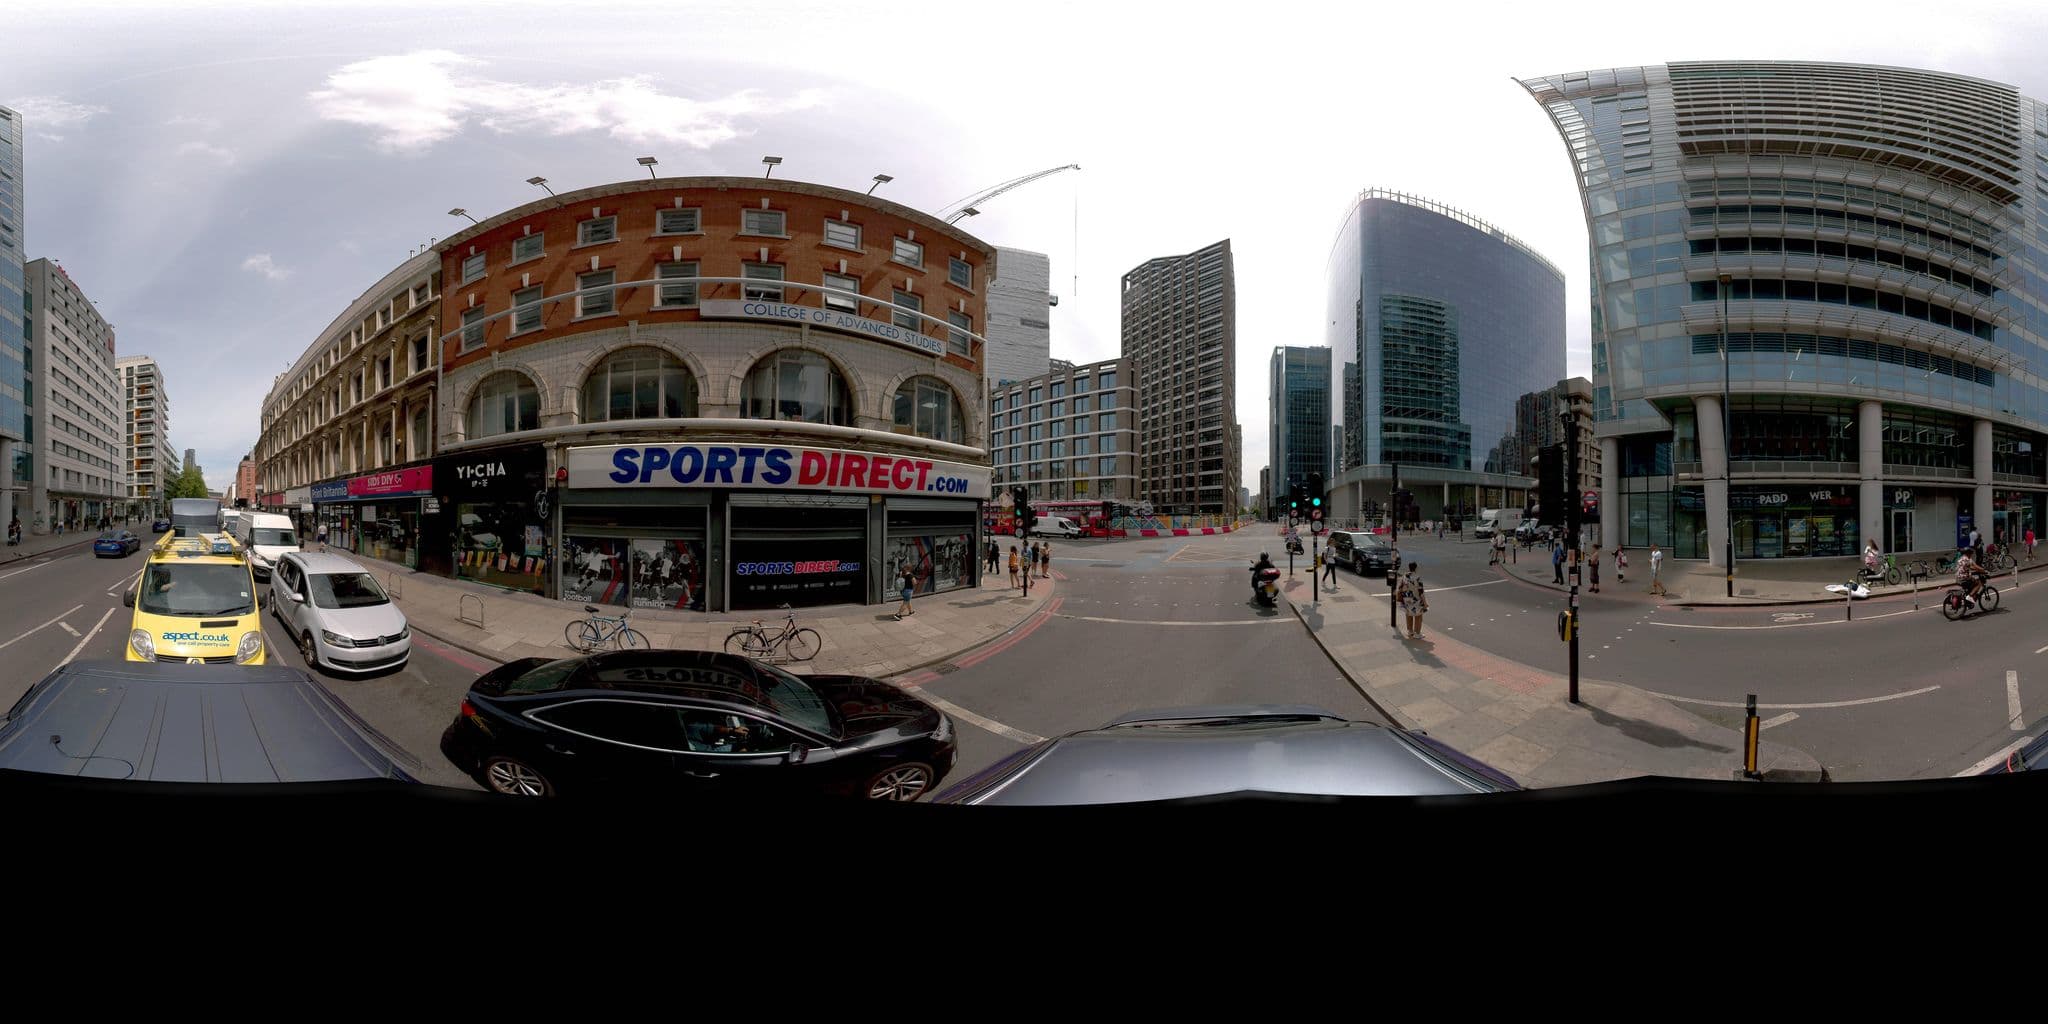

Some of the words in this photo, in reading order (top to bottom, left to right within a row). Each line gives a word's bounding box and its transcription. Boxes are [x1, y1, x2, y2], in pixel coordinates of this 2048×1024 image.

[743, 303, 807, 320] COLLEGE
[812, 310, 831, 323] OF
[836, 315, 900, 340] ADVANCED
[904, 333, 942, 353] STUDIES
[323, 484, 348, 498] Britannia
[1895, 491, 1910, 503] PP
[633, 599, 666, 609] running
[163, 632, 229, 642] aspect.co.uk
